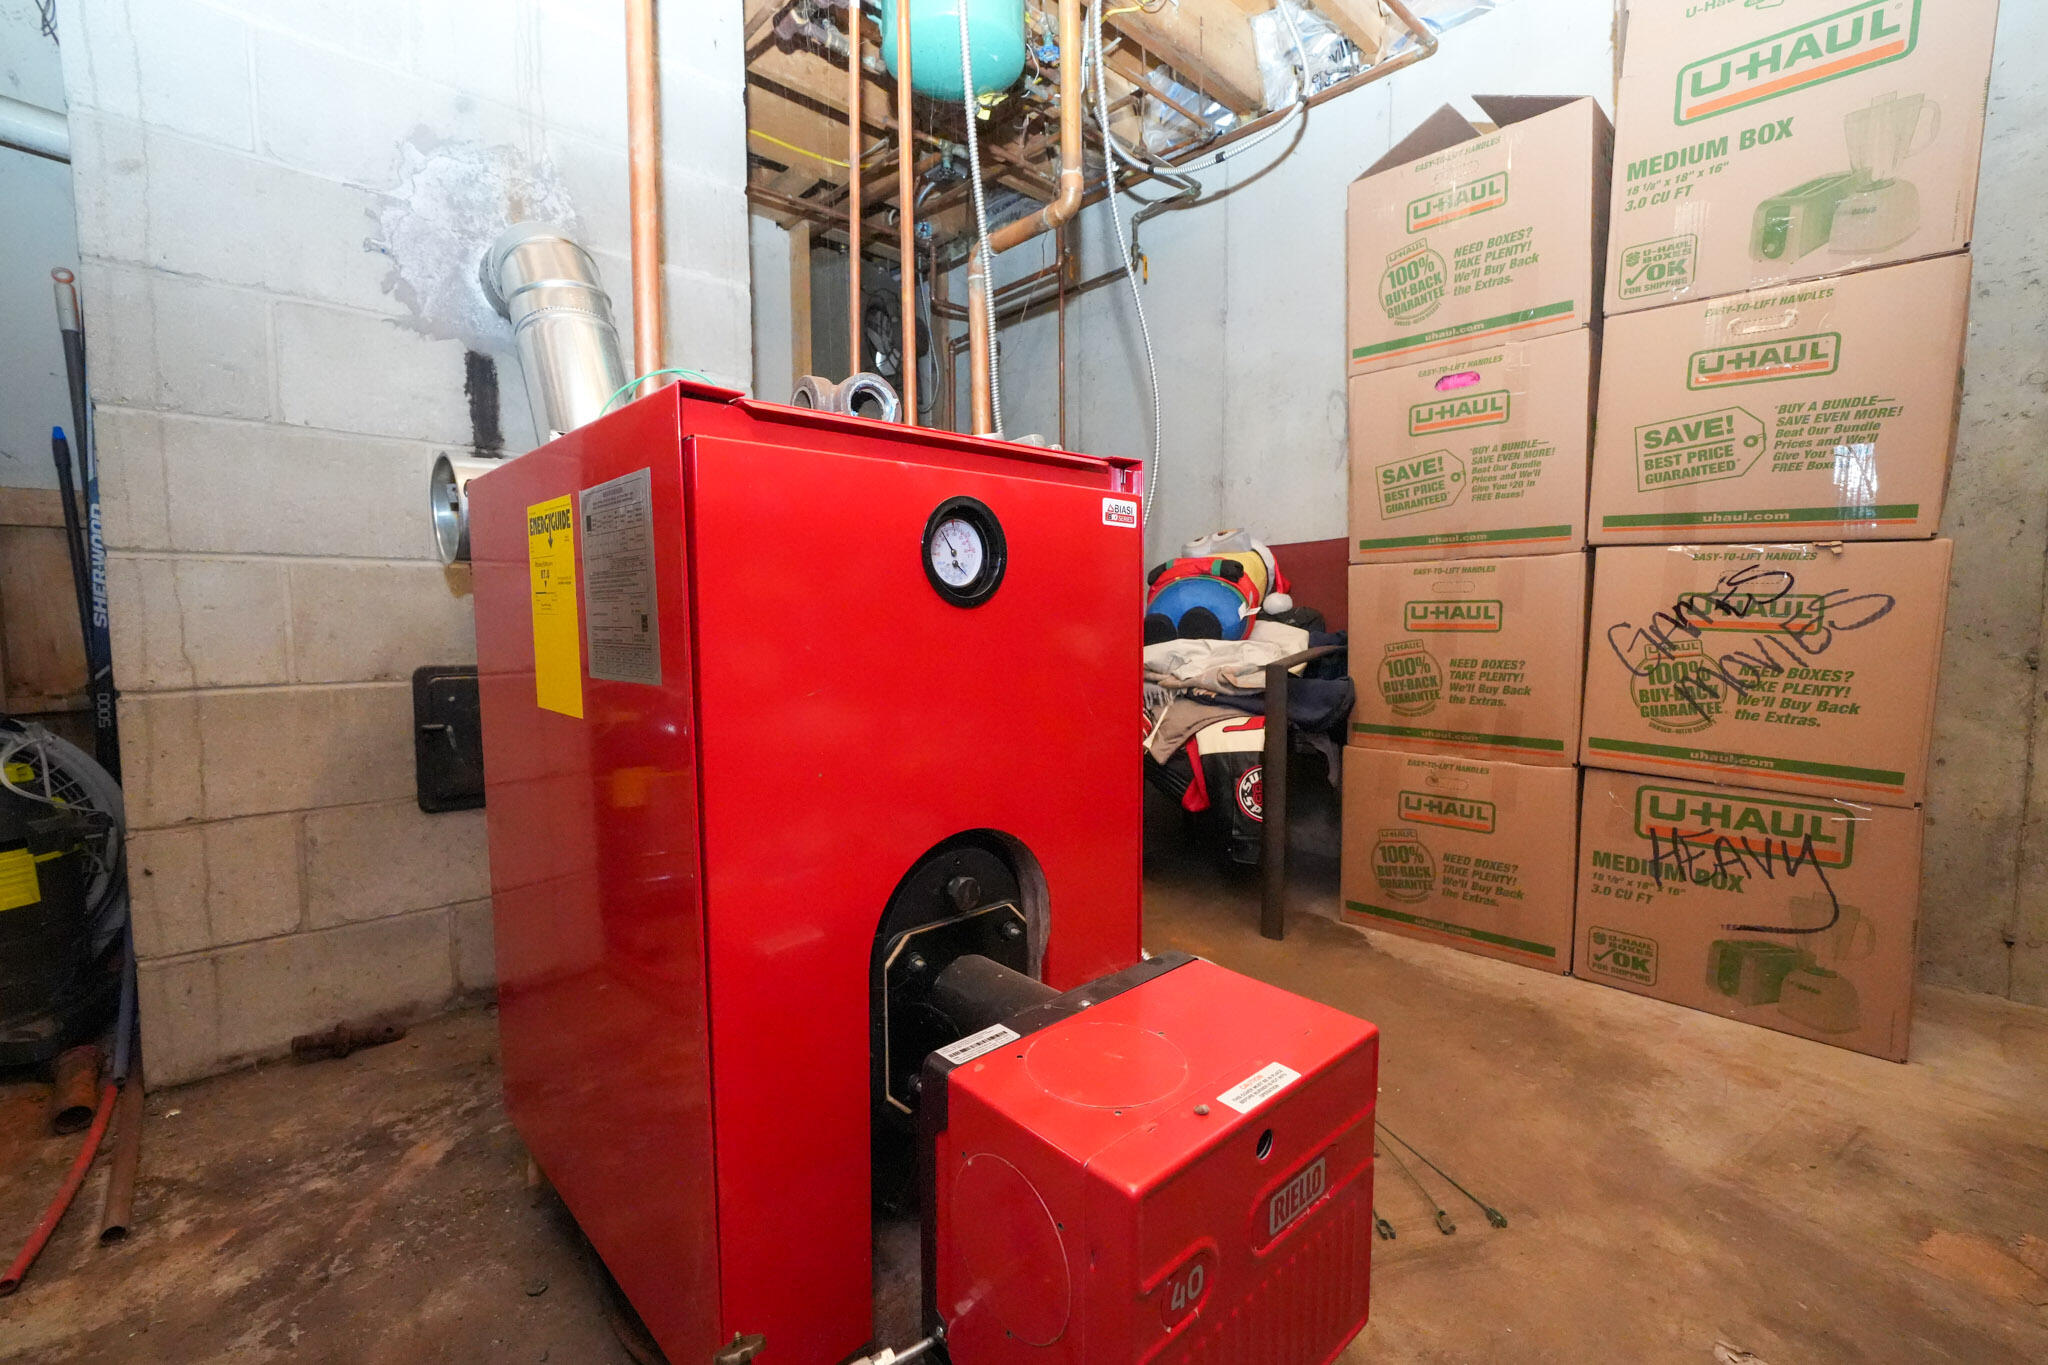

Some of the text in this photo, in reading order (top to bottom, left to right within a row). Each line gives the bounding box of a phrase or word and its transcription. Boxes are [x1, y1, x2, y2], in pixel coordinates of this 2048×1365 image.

[1690, 8, 1901, 99] U-HAUL
[1626, 116, 1795, 182] MEDIUM BOX
[1627, 185, 1640, 197] 18
[1664, 178, 1672, 187] x
[1697, 169, 1704, 178] x
[1413, 181, 1501, 219] U-HAUL
[1624, 184, 1695, 212] 3.0 CU FT
[1389, 242, 1425, 262] U-HAUL
[1454, 226, 1534, 258] NEED BOXES?
[1643, 240, 1692, 257] U-HAUL
[1454, 241, 1533, 271] TAKE PLENTY!
[1643, 248, 1691, 264] BOXES
[1387, 254, 1435, 289] 100%
[1453, 252, 1539, 284] We'll Buy Back
[1646, 259, 1688, 282] OK
[1385, 271, 1443, 307] BUY-BACK
[1453, 275, 1514, 297] the Extras.
[1624, 286, 1642, 296] FOR
[1387, 285, 1445, 319] GUARANTEE
[1779, 288, 1835, 305] HANDLES
[1425, 322, 1485, 341] uhaul.com
[1466, 354, 1504, 370] HANDLES
[1699, 340, 1829, 374] U-HAUL
[1415, 397, 1504, 424] U-HAUL
[1776, 406, 1904, 427] SAVE EVEN MORE!
[1807, 401, 1817, 412] A
[1643, 415, 1734, 450] SAVE!
[1775, 421, 1881, 438] Beat Our Bundle
[1492, 444, 1498, 453] A
[1773, 433, 1879, 450] Prices and We'll
[1471, 447, 1556, 465] SAVE EVEN MORE!
[1510, 460, 1542, 470] Bundle
[1644, 444, 1734, 471] BEST PRICE
[1773, 451, 1800, 461] Give
[1804, 450, 1827, 459] You
[1382, 456, 1444, 485] SAVE!
[1645, 459, 1736, 485] GUARANTEED
[1771, 462, 1803, 472] FREE
[1384, 480, 1446, 503] BEST PRICE
[1471, 493, 1493, 502] FREE
[1114, 504, 1133, 515] BIASI
[1385, 492, 1448, 514] GUARANTEED
[1702, 510, 1790, 523] uhaul.com
[1428, 533, 1487, 544] uhaul.com
[89, 503, 109, 629] SHERWOOD
[1692, 551, 1818, 561] EASY-TO-LIFT HANDLES
[1413, 565, 1496, 576] EASY-TO-LIFT HANDLES
[1410, 605, 1496, 620] U-HAUL
[1384, 656, 1431, 678] 100%
[1449, 659, 1526, 670] NEED BOXES?
[1643, 660, 1711, 686] 100%
[1738, 665, 1855, 682] NEED BOXES?
[1384, 675, 1438, 693] BUY-BACK
[1450, 671, 1524, 683] TAKE PLENTY!
[1385, 688, 1442, 705] GUARANTEE
[1449, 683, 1532, 697] We'll Buy Back
[1639, 684, 1719, 703] BUY-BACK
[1781, 682, 1852, 699] PLENTY!
[96, 692, 112, 729] 5000
[1449, 695, 1507, 707] the Extras.
[1640, 702, 1723, 718] GUARANTEE
[1736, 694, 1862, 715] We'll Buy Back
[1734, 709, 1821, 727] the Extras.
[1455, 764, 1489, 775] HANDLES
[1690, 751, 1775, 770] uhaul.com
[1404, 796, 1489, 821] U-HAUL
[1649, 796, 1837, 844] U-HAUL
[1379, 845, 1424, 864] 100%
[1443, 853, 1519, 874] NEED BOXES?
[1443, 864, 1517, 886] TAKE PLENTY!
[1592, 850, 1745, 894] MEDIUM BOX
[1649, 827, 1840, 935] HEAVY
[1471, 881, 1493, 895] Buy
[1591, 884, 1654, 905] 3.0 CU FT
[1612, 951, 1651, 974] OK
[1170, 1264, 1204, 1311] 40
